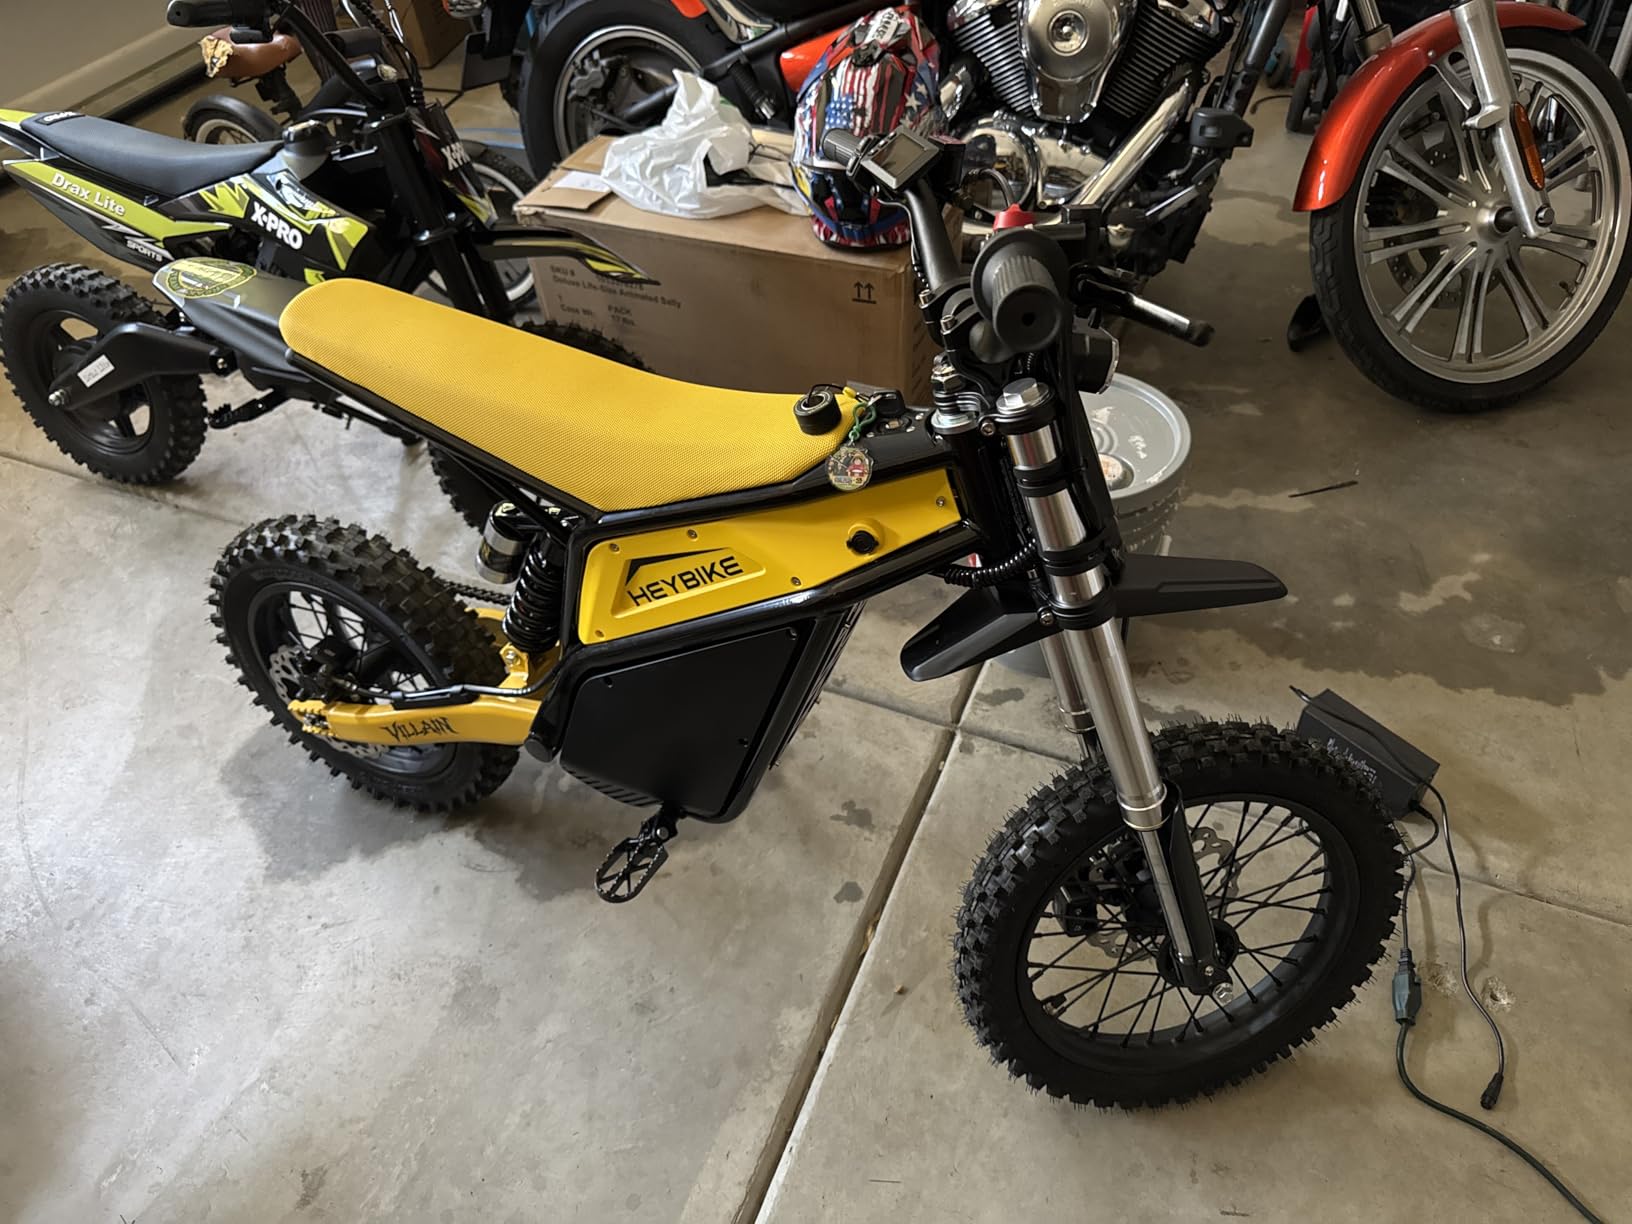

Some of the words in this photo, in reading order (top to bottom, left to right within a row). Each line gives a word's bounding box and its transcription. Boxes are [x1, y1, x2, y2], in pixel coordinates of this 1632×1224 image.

[52, 172, 90, 200] Drax
[94, 192, 126, 216] Lite
[126, 240, 163, 262] SPORTS
[550, 265, 569, 276] SKU
[553, 275, 580, 287] Deluxe
[620, 289, 659, 303] Animated
[607, 304, 633, 316] PACK
[627, 556, 744, 606] HEYBIKE
[379, 715, 459, 742] VILLAIN
